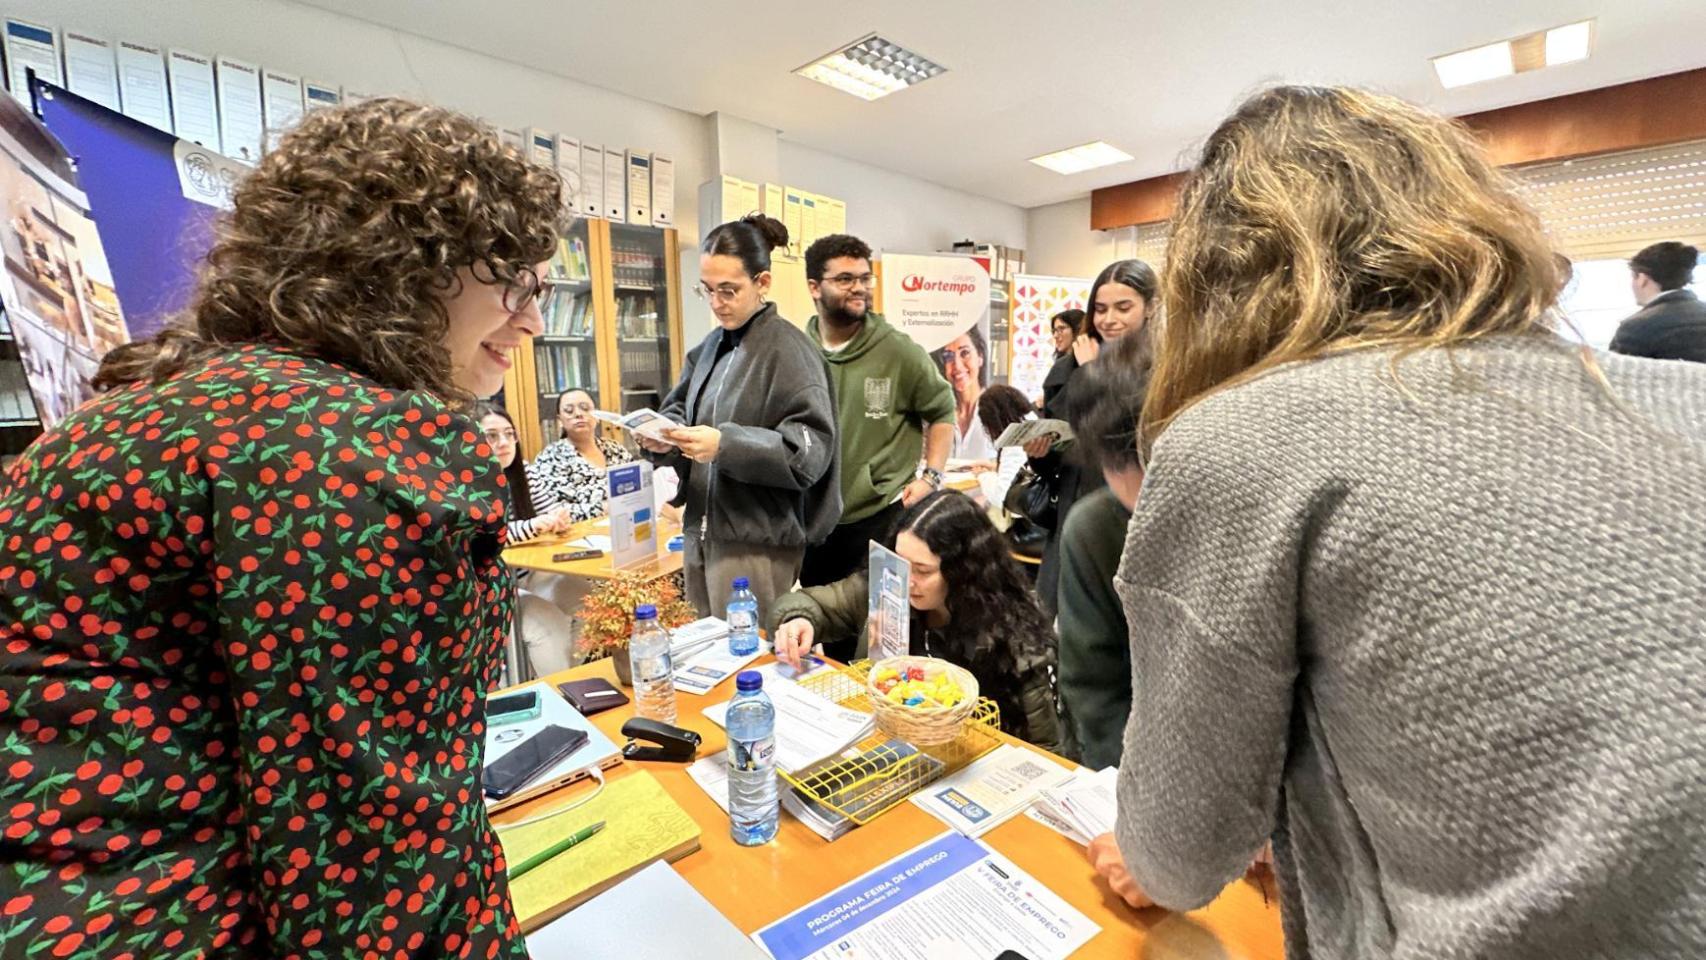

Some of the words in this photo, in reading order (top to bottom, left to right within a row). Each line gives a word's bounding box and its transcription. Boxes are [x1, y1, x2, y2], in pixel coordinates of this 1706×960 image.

[904, 276, 976, 295] Nortempo
[902, 309, 929, 317] Expertos
[806, 897, 865, 928] PROGRAMA
[863, 881, 894, 900] FEIRA
[892, 873, 907, 884] DE
[906, 850, 949, 877] EMPREGO
[983, 872, 1007, 893] FEIRA
[1007, 891, 1022, 903] DE
[1020, 902, 1066, 939] EMPREGO
